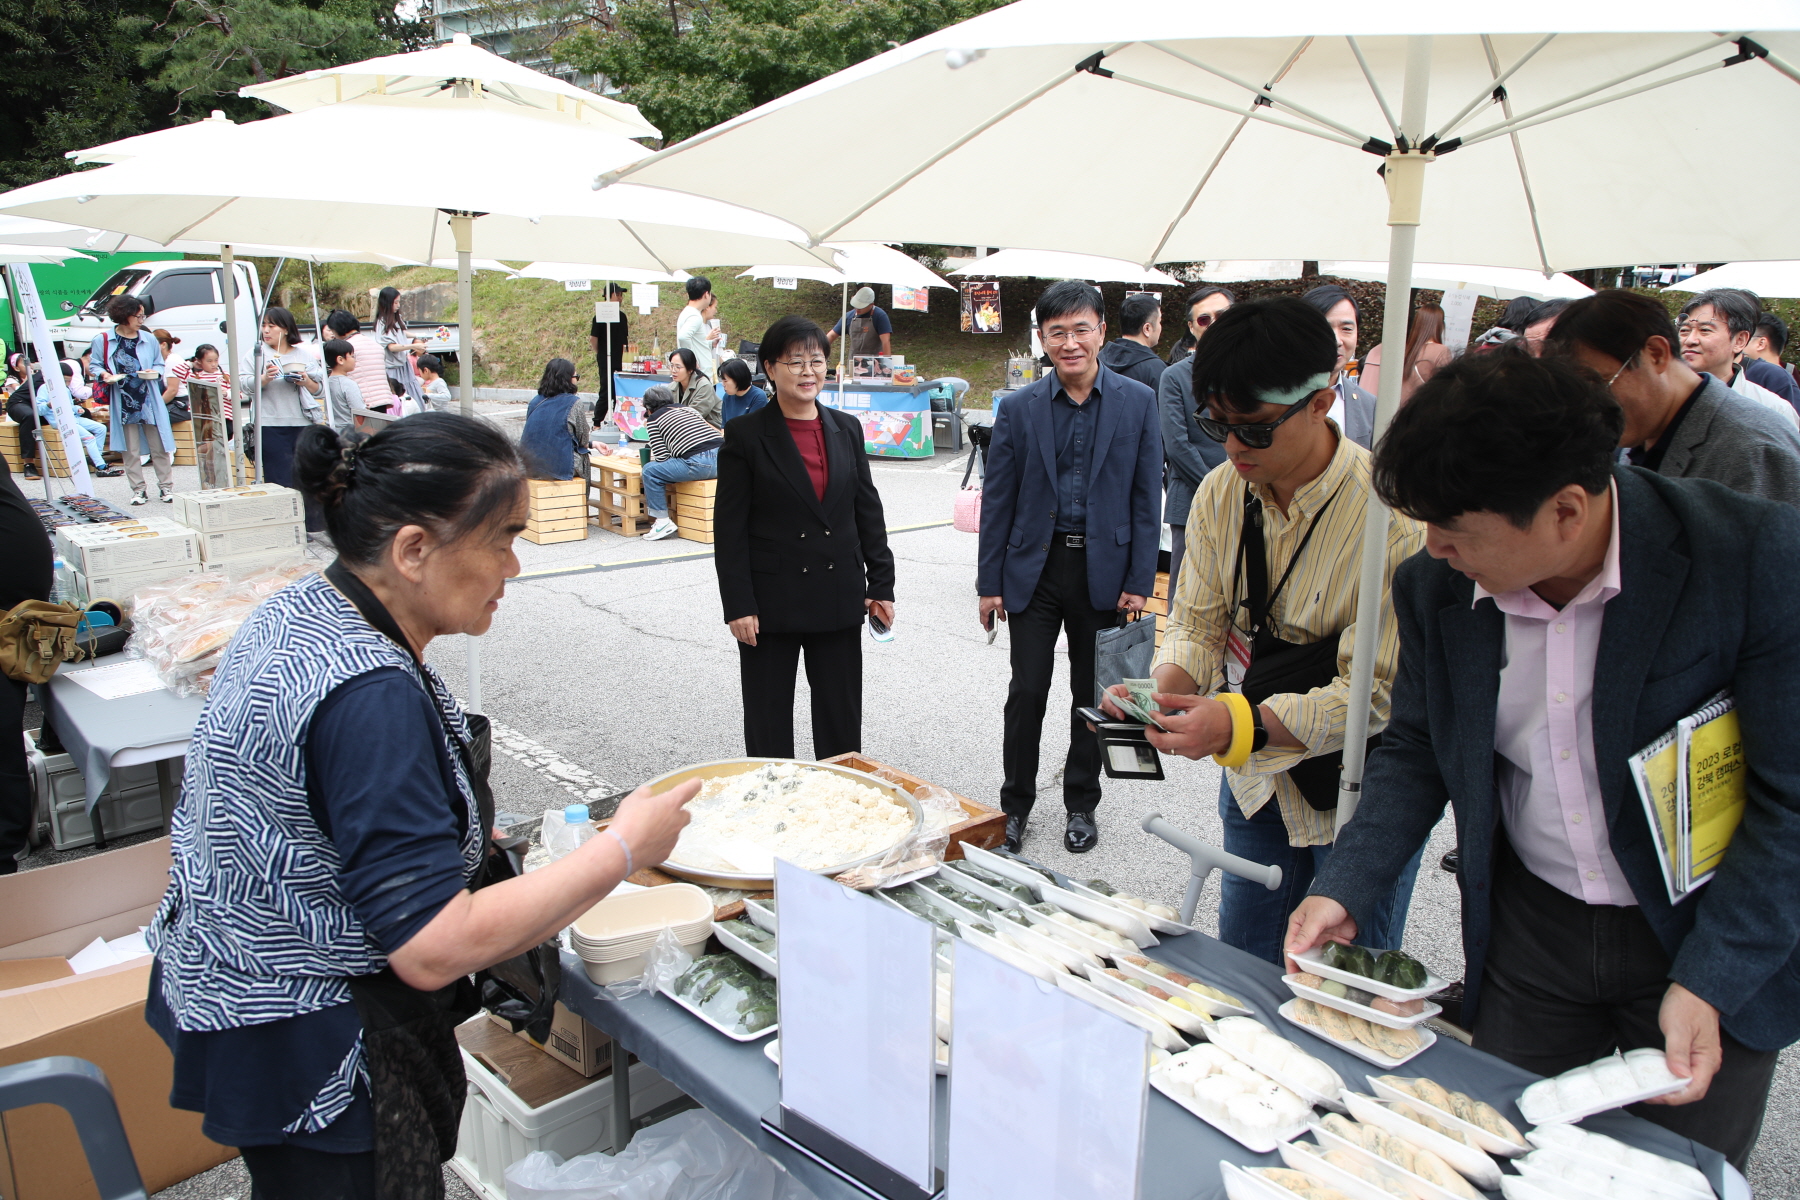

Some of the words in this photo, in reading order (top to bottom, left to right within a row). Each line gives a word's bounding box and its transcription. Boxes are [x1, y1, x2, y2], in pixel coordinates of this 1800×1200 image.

[1696, 752, 1720, 774] 2023
[1722, 741, 1742, 760] 로컬
[1660, 778, 1677, 799] 20
[1697, 771, 1714, 790] 강북
[1715, 758, 1742, 781] 캠퍼스
